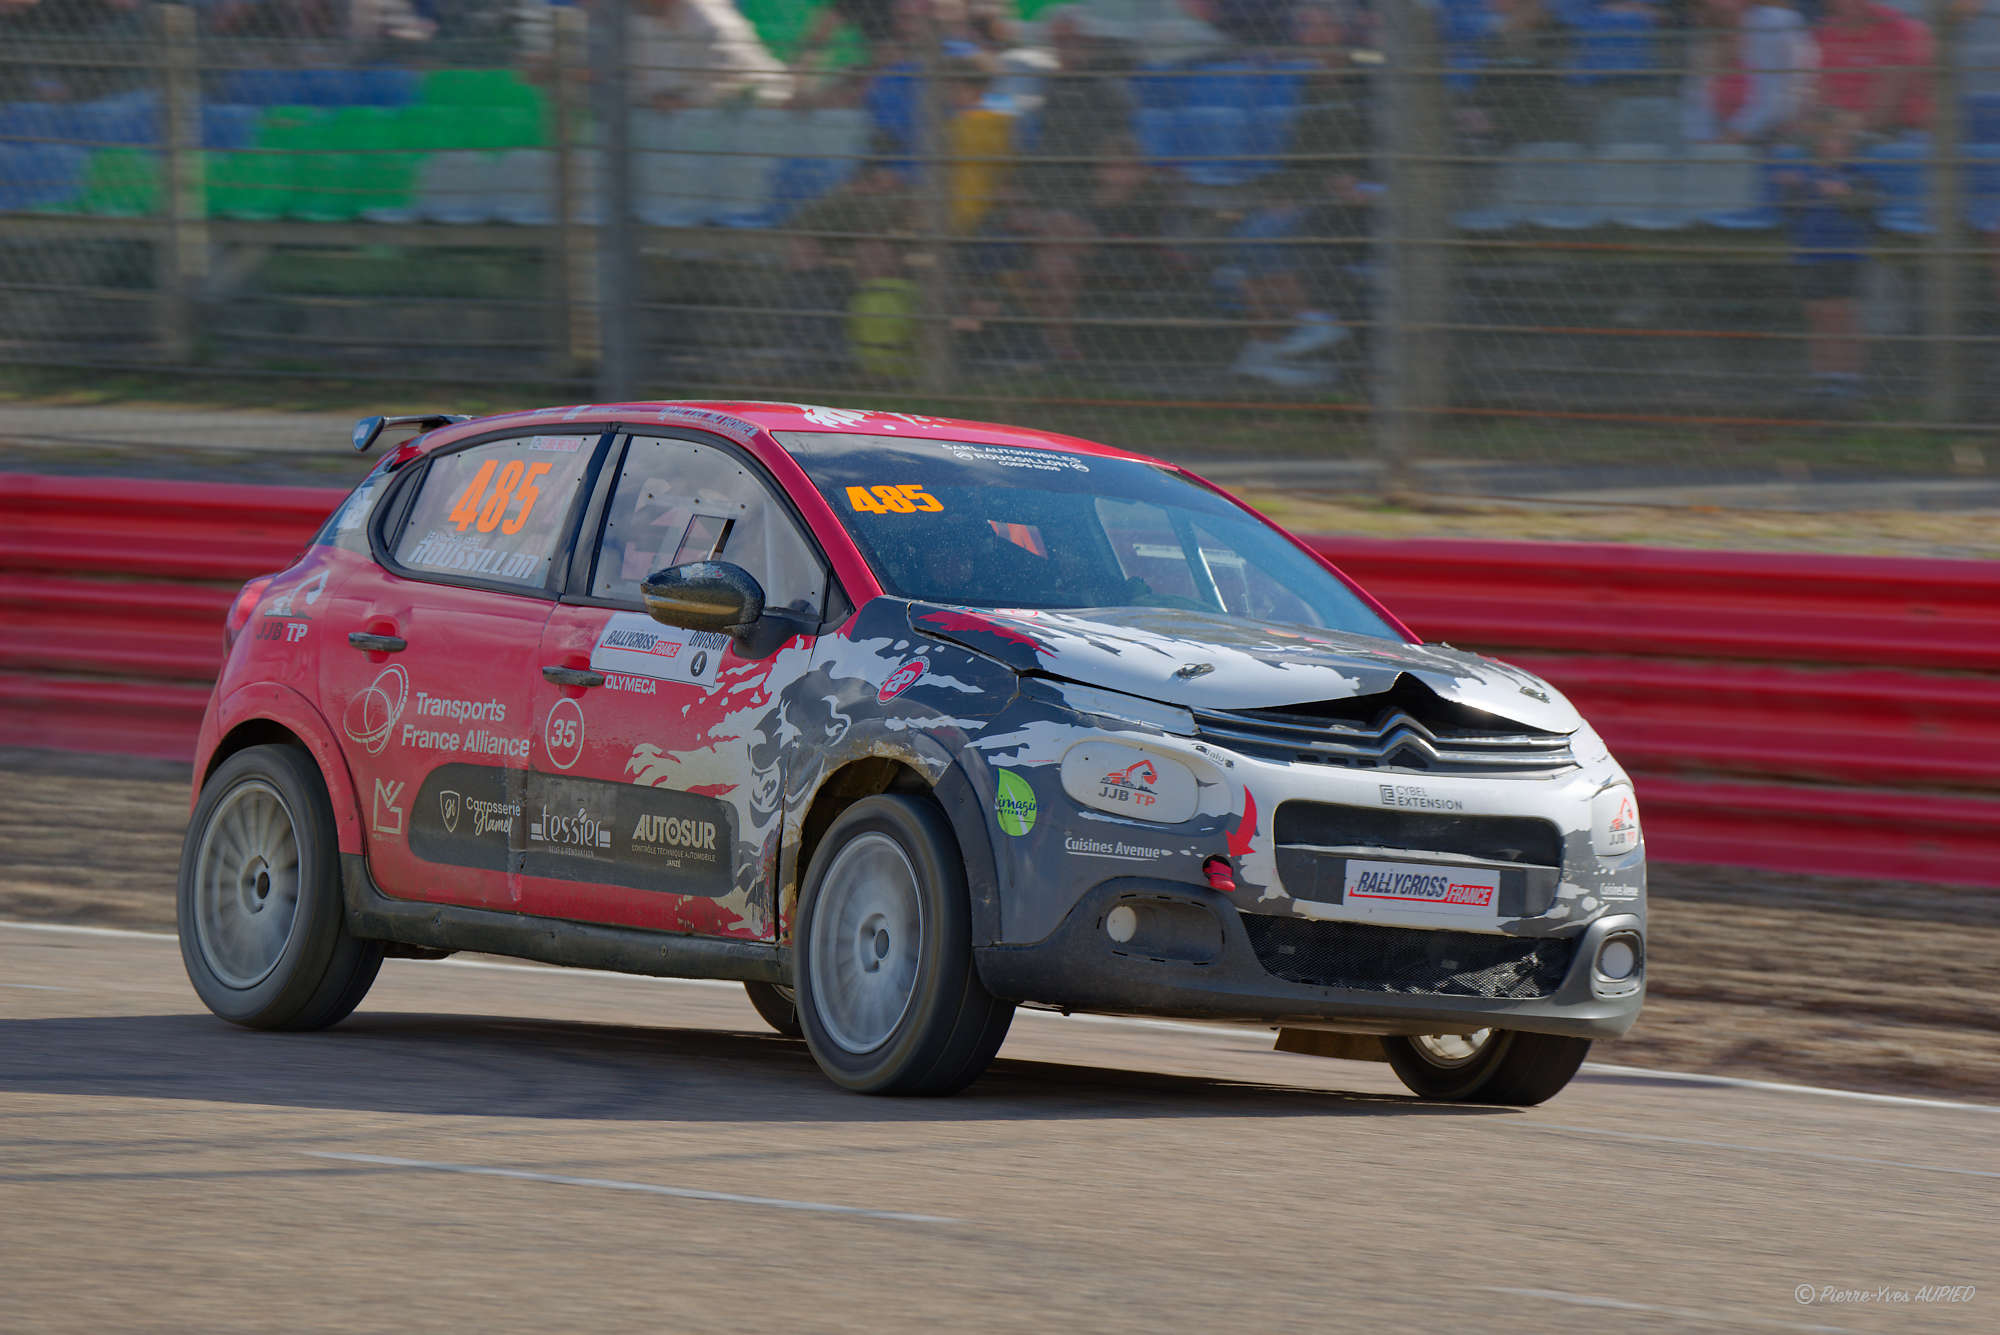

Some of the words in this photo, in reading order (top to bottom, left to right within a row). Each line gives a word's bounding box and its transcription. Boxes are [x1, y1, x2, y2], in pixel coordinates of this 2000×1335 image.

[974, 452, 1070, 469] ROUSSILLON
[985, 447, 1081, 463] AUTOMOBILES
[448, 459, 553, 535] 485
[845, 484, 944, 514] 485
[286, 622, 308, 642] TP
[688, 631, 731, 652] DIVISION
[604, 630, 658, 651] RALLYCROSS
[653, 641, 681, 658] FRANCE
[693, 655, 703, 674] 4
[605, 674, 656, 695] OLYMECA
[416, 691, 506, 724] Transports
[401, 724, 460, 752] France
[463, 729, 530, 758] Alliance
[551, 719, 577, 748] 35
[1098, 786, 1130, 802] JJB
[1133, 792, 1157, 806] TP
[1396, 785, 1428, 797] CYBEL
[466, 796, 521, 817] Carrosserie
[1397, 797, 1463, 811] EXTENSION
[474, 807, 513, 837] Hamel
[542, 804, 601, 848] tessier
[632, 814, 716, 850] AUTOSUR
[657, 847, 684, 858] TECHNIQUE
[685, 851, 716, 863] AUTOMOBILE
[1065, 837, 1113, 853] Cuisines
[1115, 841, 1160, 858] Avenue
[1357, 871, 1448, 898] RALLYCROSS
[1447, 885, 1492, 906] FRANCE
